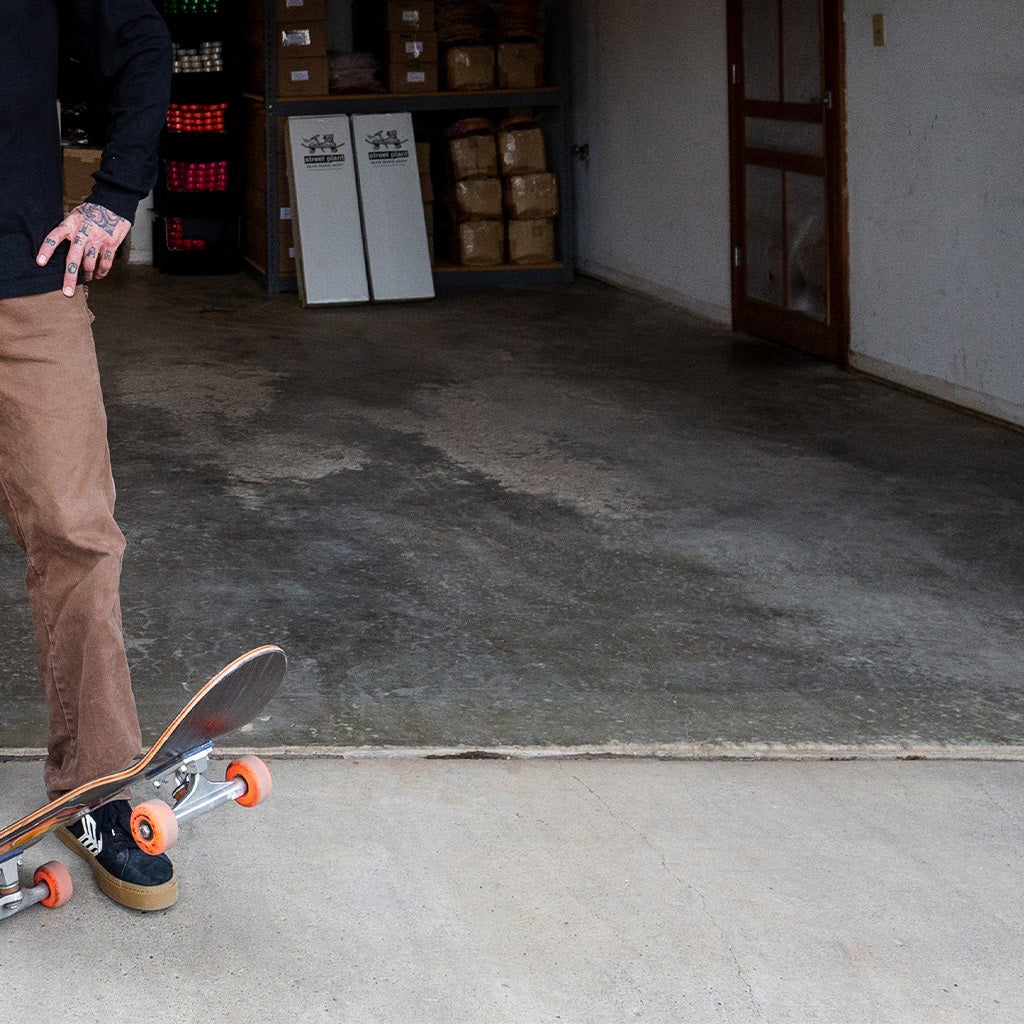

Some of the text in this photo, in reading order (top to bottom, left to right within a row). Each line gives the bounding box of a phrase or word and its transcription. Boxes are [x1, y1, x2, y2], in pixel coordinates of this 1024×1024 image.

[304, 154, 345, 163] street plant
[369, 150, 409, 159] street plant
